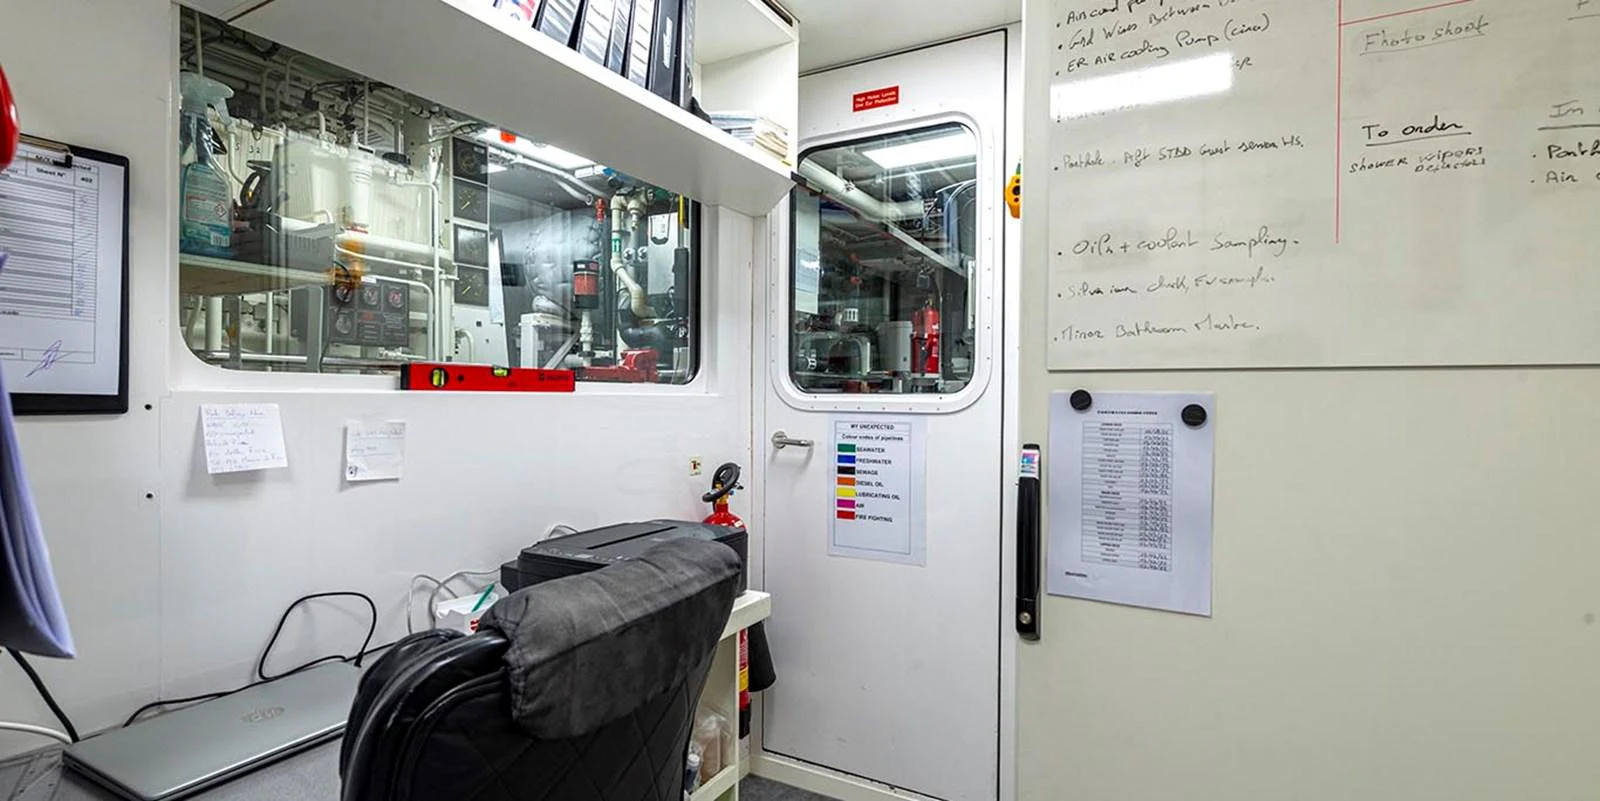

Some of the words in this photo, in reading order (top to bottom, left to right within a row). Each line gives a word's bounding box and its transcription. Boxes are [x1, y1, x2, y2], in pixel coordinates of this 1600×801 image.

[1067, 57, 1088, 72] ER
[1361, 123, 1389, 140] To
[855, 491, 891, 499] LUBRICATING
[867, 514, 893, 523] FIGHTING
